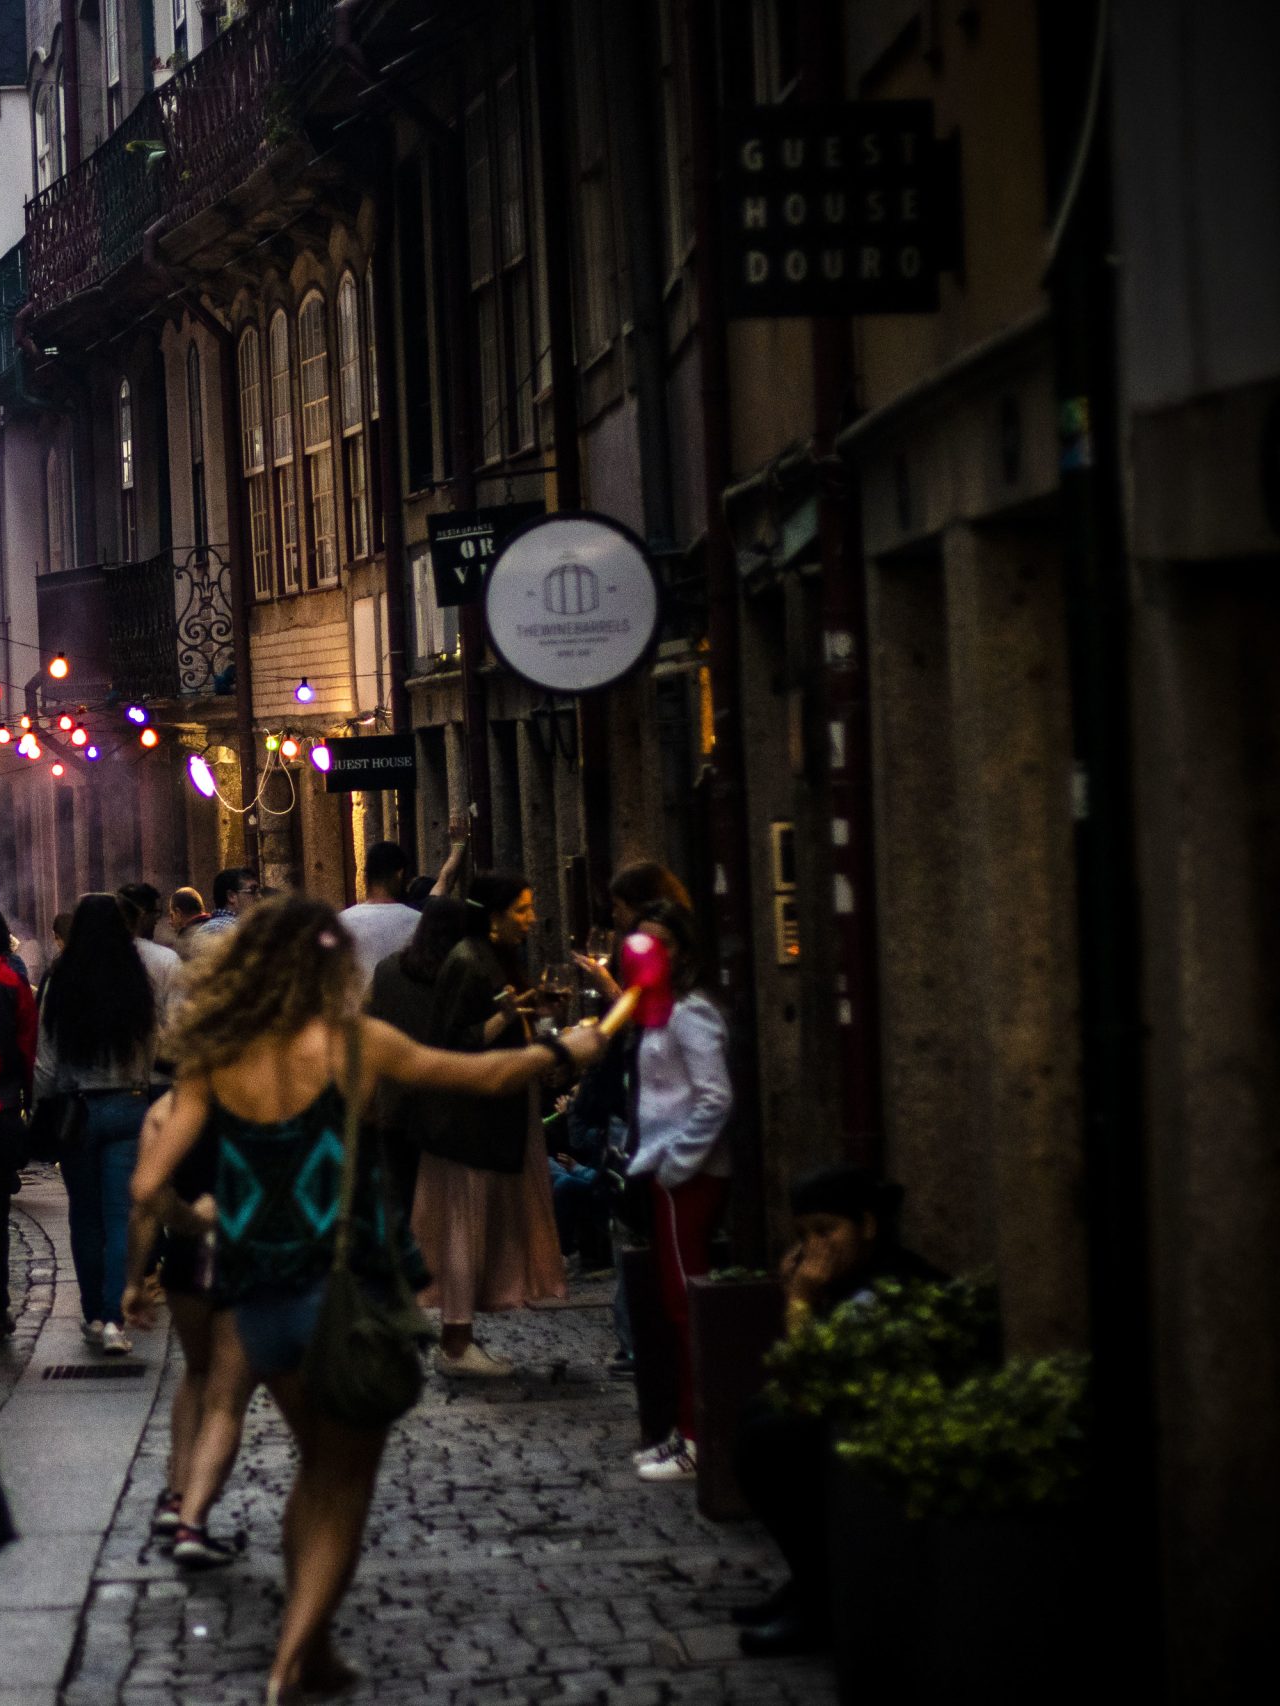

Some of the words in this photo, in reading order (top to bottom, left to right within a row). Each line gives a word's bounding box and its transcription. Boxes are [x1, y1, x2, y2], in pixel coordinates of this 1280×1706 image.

[741, 131, 919, 173] GUEST
[742, 187, 919, 231] HOUSE
[745, 245, 924, 285] DOURO
[333, 758, 369, 770] UEST
[372, 756, 413, 769] HOUSE
